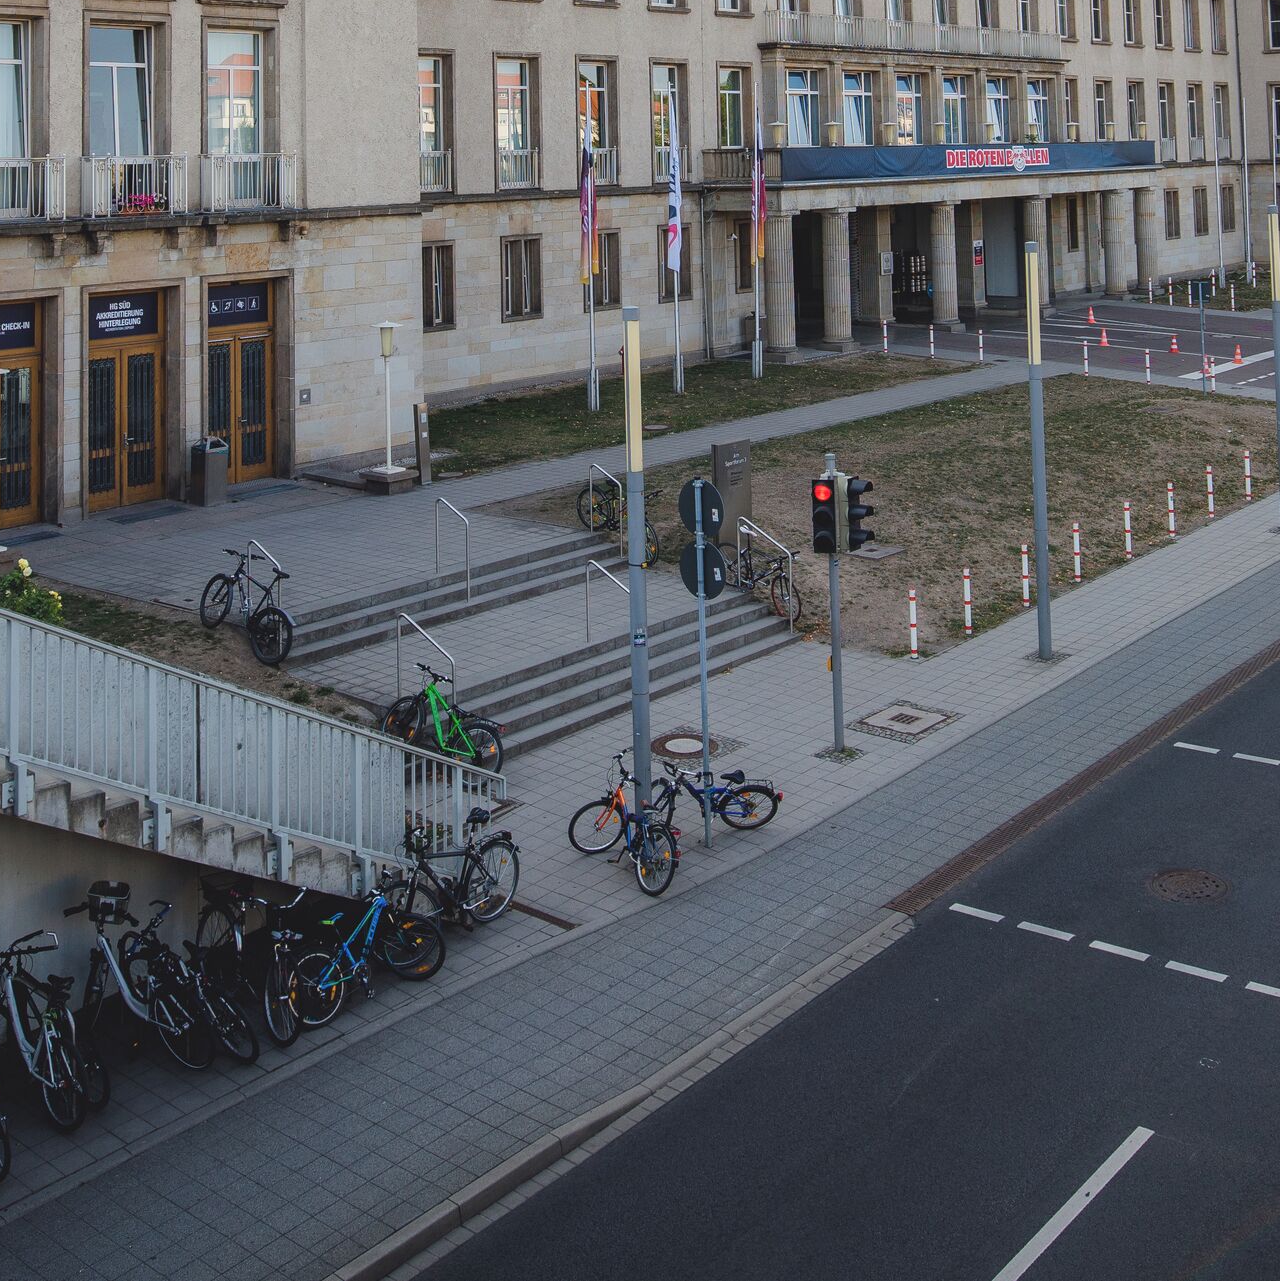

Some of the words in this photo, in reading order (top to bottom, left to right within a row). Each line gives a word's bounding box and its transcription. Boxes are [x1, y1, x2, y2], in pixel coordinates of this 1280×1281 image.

[946, 149, 967, 168] DIE
[967, 148, 1005, 168] ROTEN
[1005, 147, 1050, 168] BLLEN
[109, 302, 118, 310] HG
[118, 300, 131, 310] SÜD
[95, 309, 144, 320] AKKREDITIERUNG
[1, 321, 30, 331] CHECK-IN
[98, 317, 141, 329] HINTERLEGUNG
